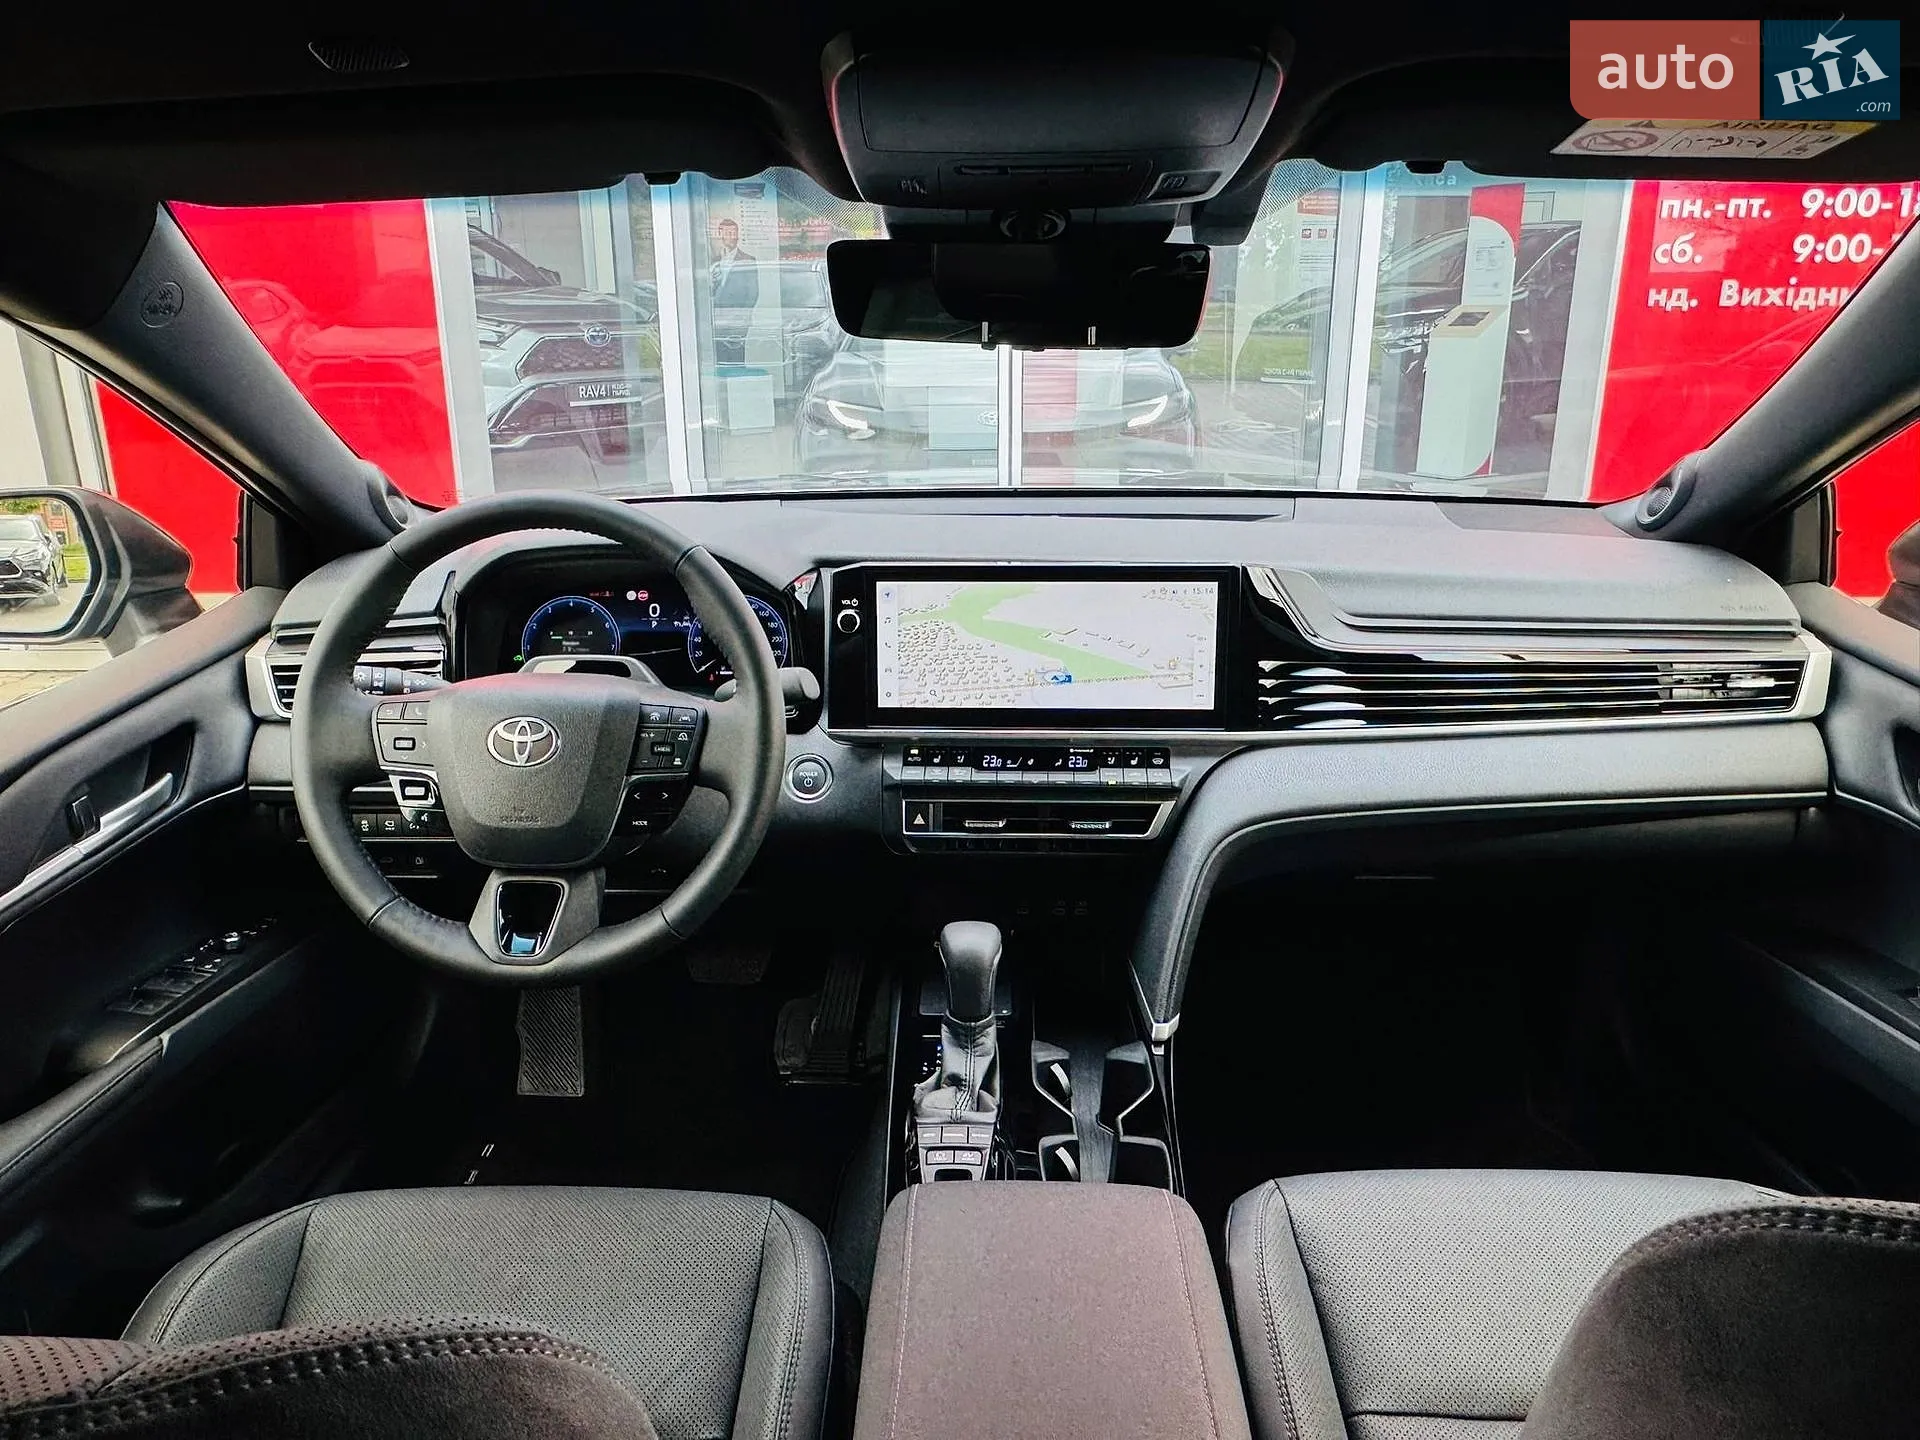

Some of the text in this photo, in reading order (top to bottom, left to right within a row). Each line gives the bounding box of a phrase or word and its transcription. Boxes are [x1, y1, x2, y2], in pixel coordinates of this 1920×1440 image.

[1660, 197, 1772, 219] пн.-пт.
[1654, 231, 1902, 264] сб. 9:00-
[1647, 287, 1698, 312] нд.
[579, 384, 606, 398] RAV4
[648, 602, 661, 618] 0
[651, 620, 658, 629] P
